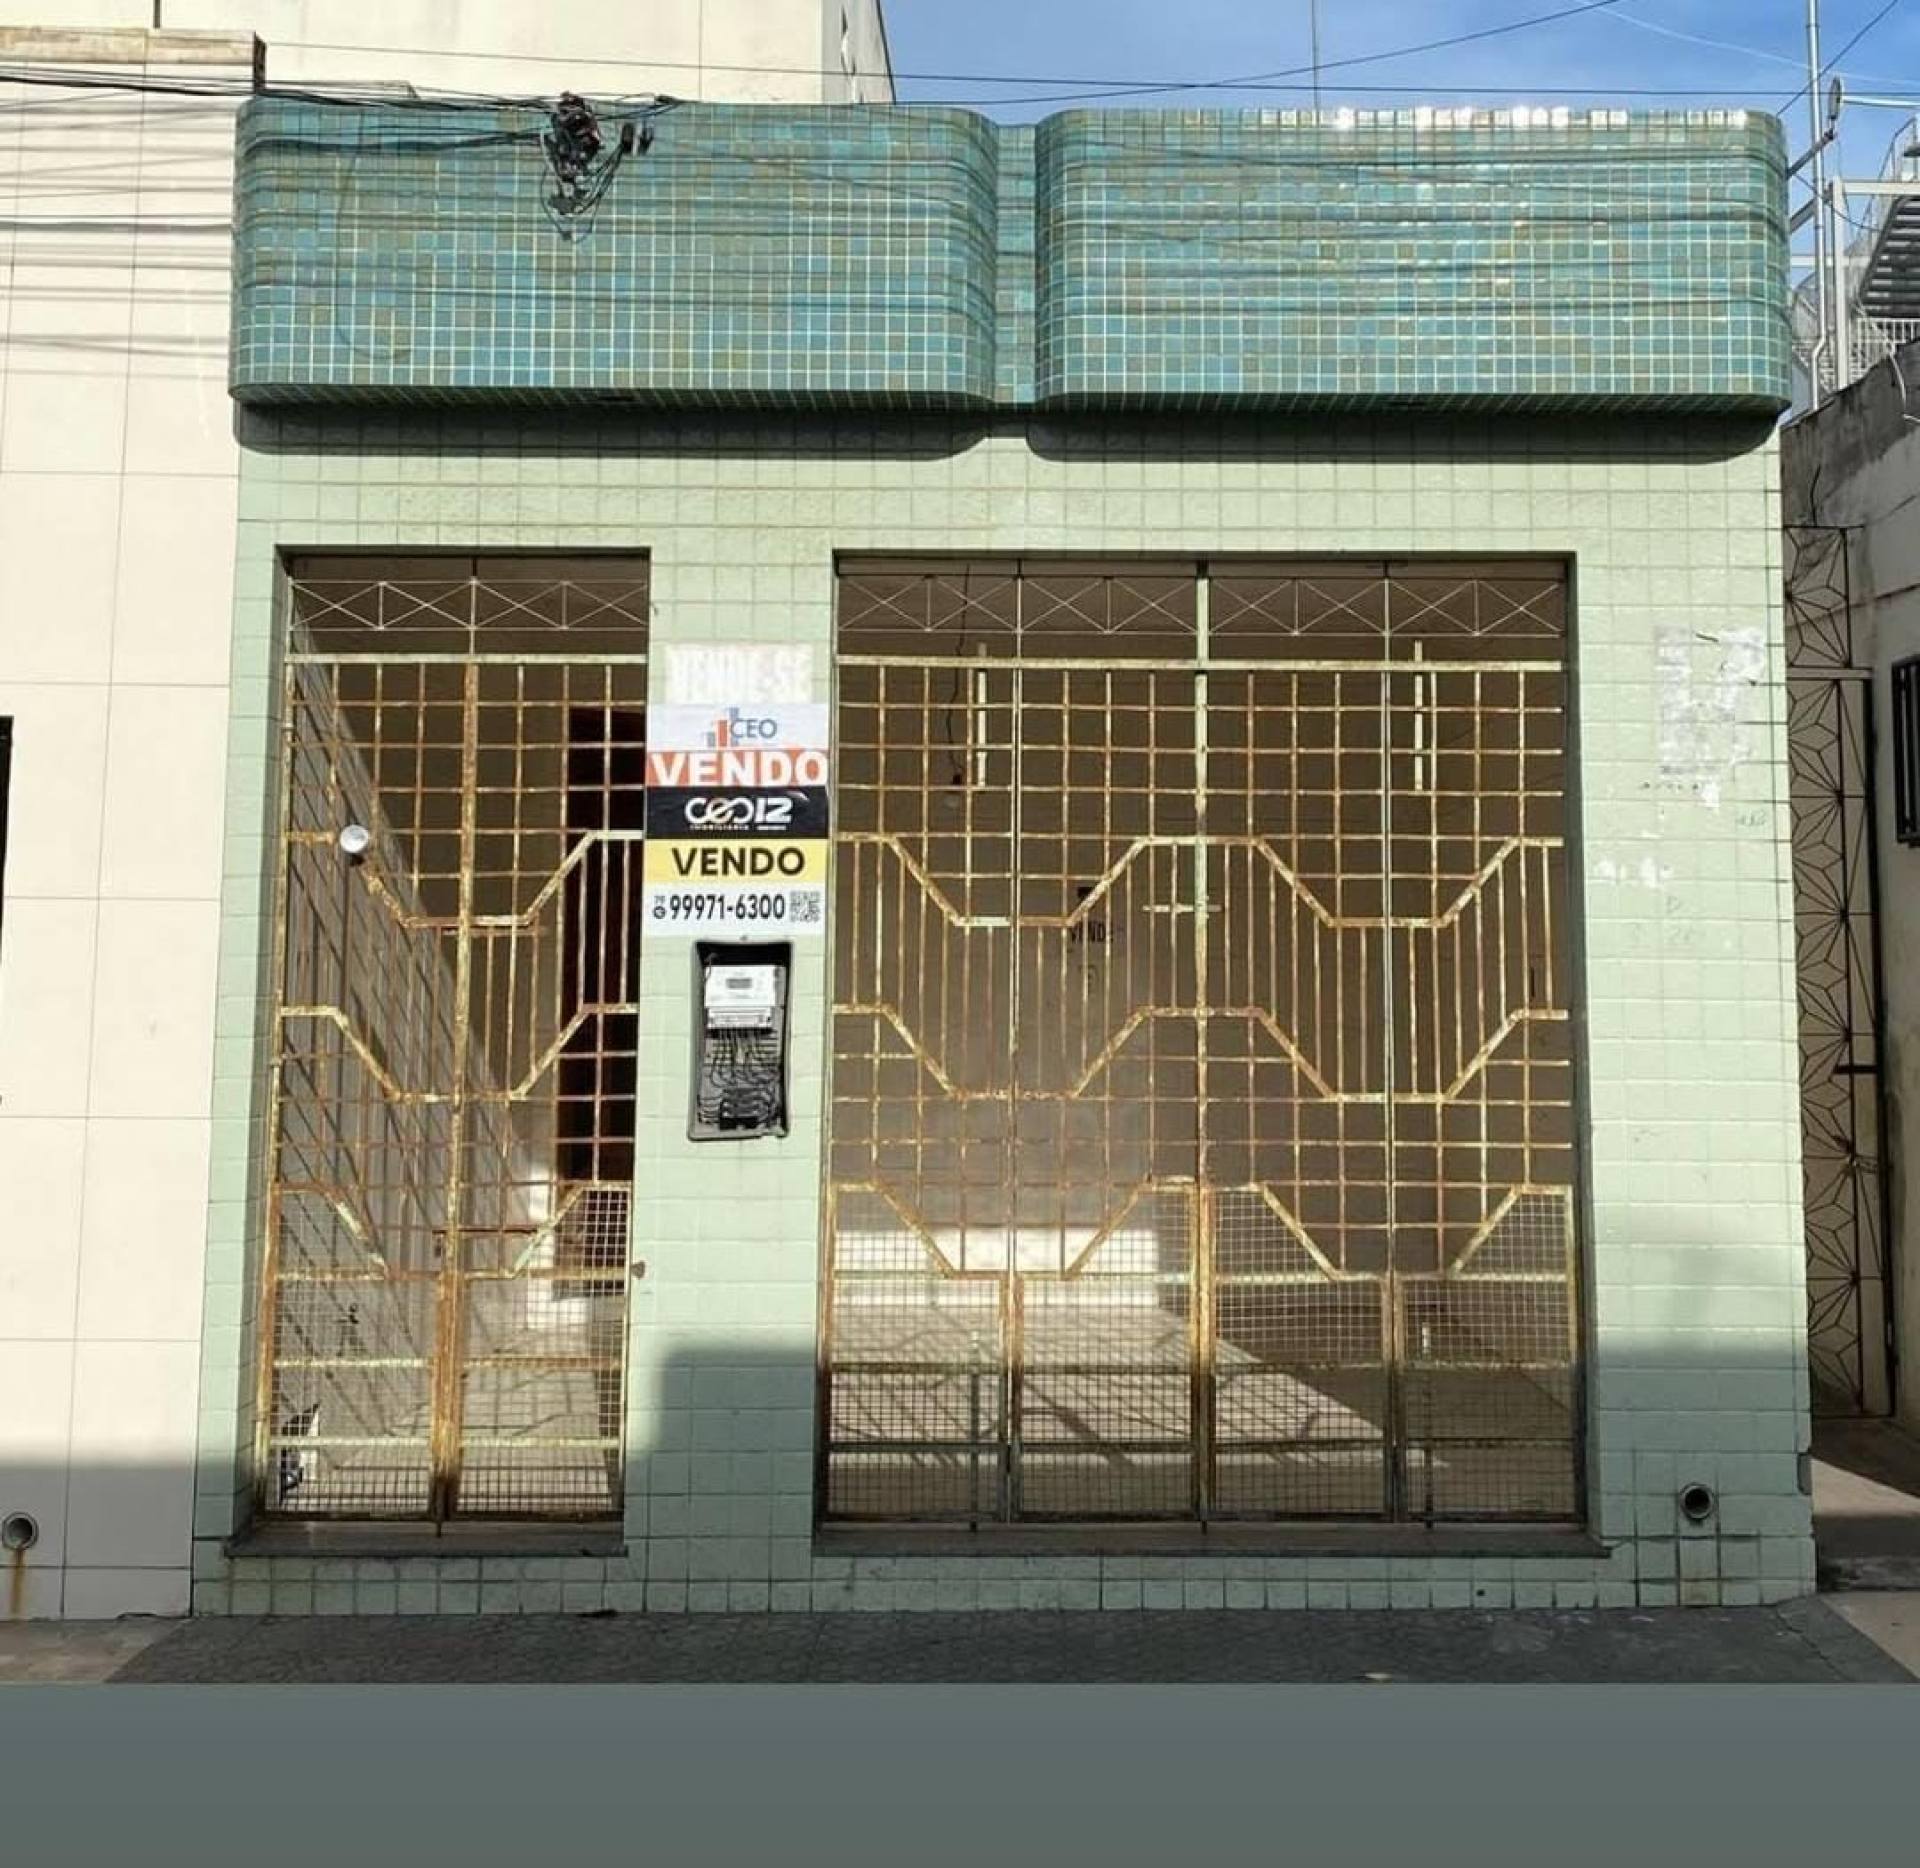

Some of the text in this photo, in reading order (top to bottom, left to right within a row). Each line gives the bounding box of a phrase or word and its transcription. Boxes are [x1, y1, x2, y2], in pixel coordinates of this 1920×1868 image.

[731, 719, 778, 739] CEO
[651, 751, 828, 786] VENDO
[672, 847, 805, 876] VENDO
[669, 894, 785, 920] 99971-6300
